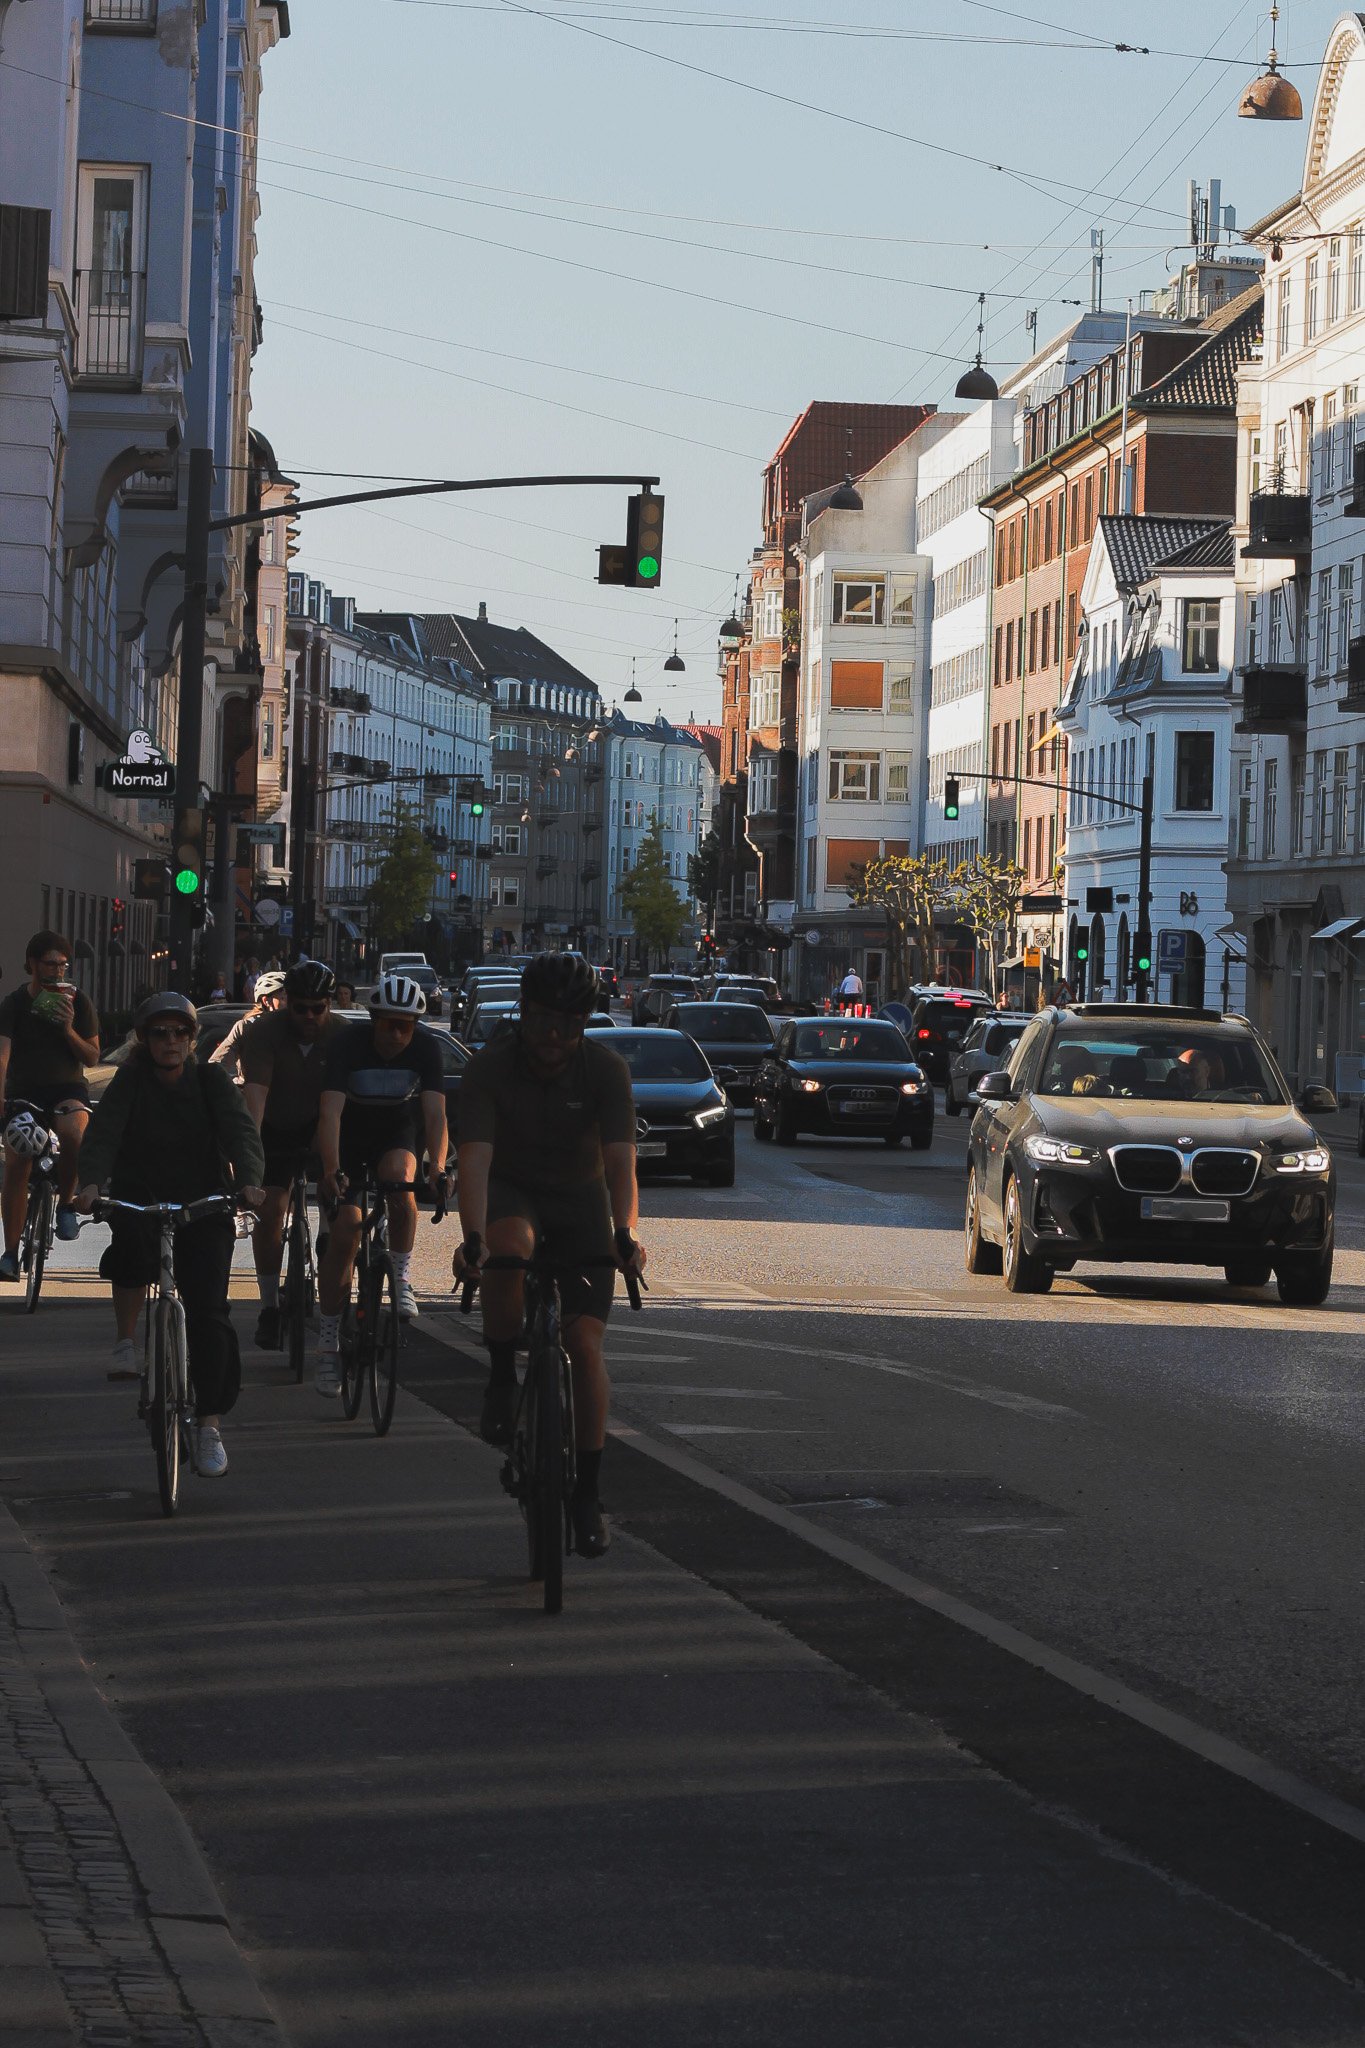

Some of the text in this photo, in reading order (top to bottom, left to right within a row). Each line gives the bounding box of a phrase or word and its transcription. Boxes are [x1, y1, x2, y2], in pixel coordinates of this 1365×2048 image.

[112, 769, 168, 787] Normal
[283, 910, 294, 923] P
[1166, 935, 1182, 955] P
